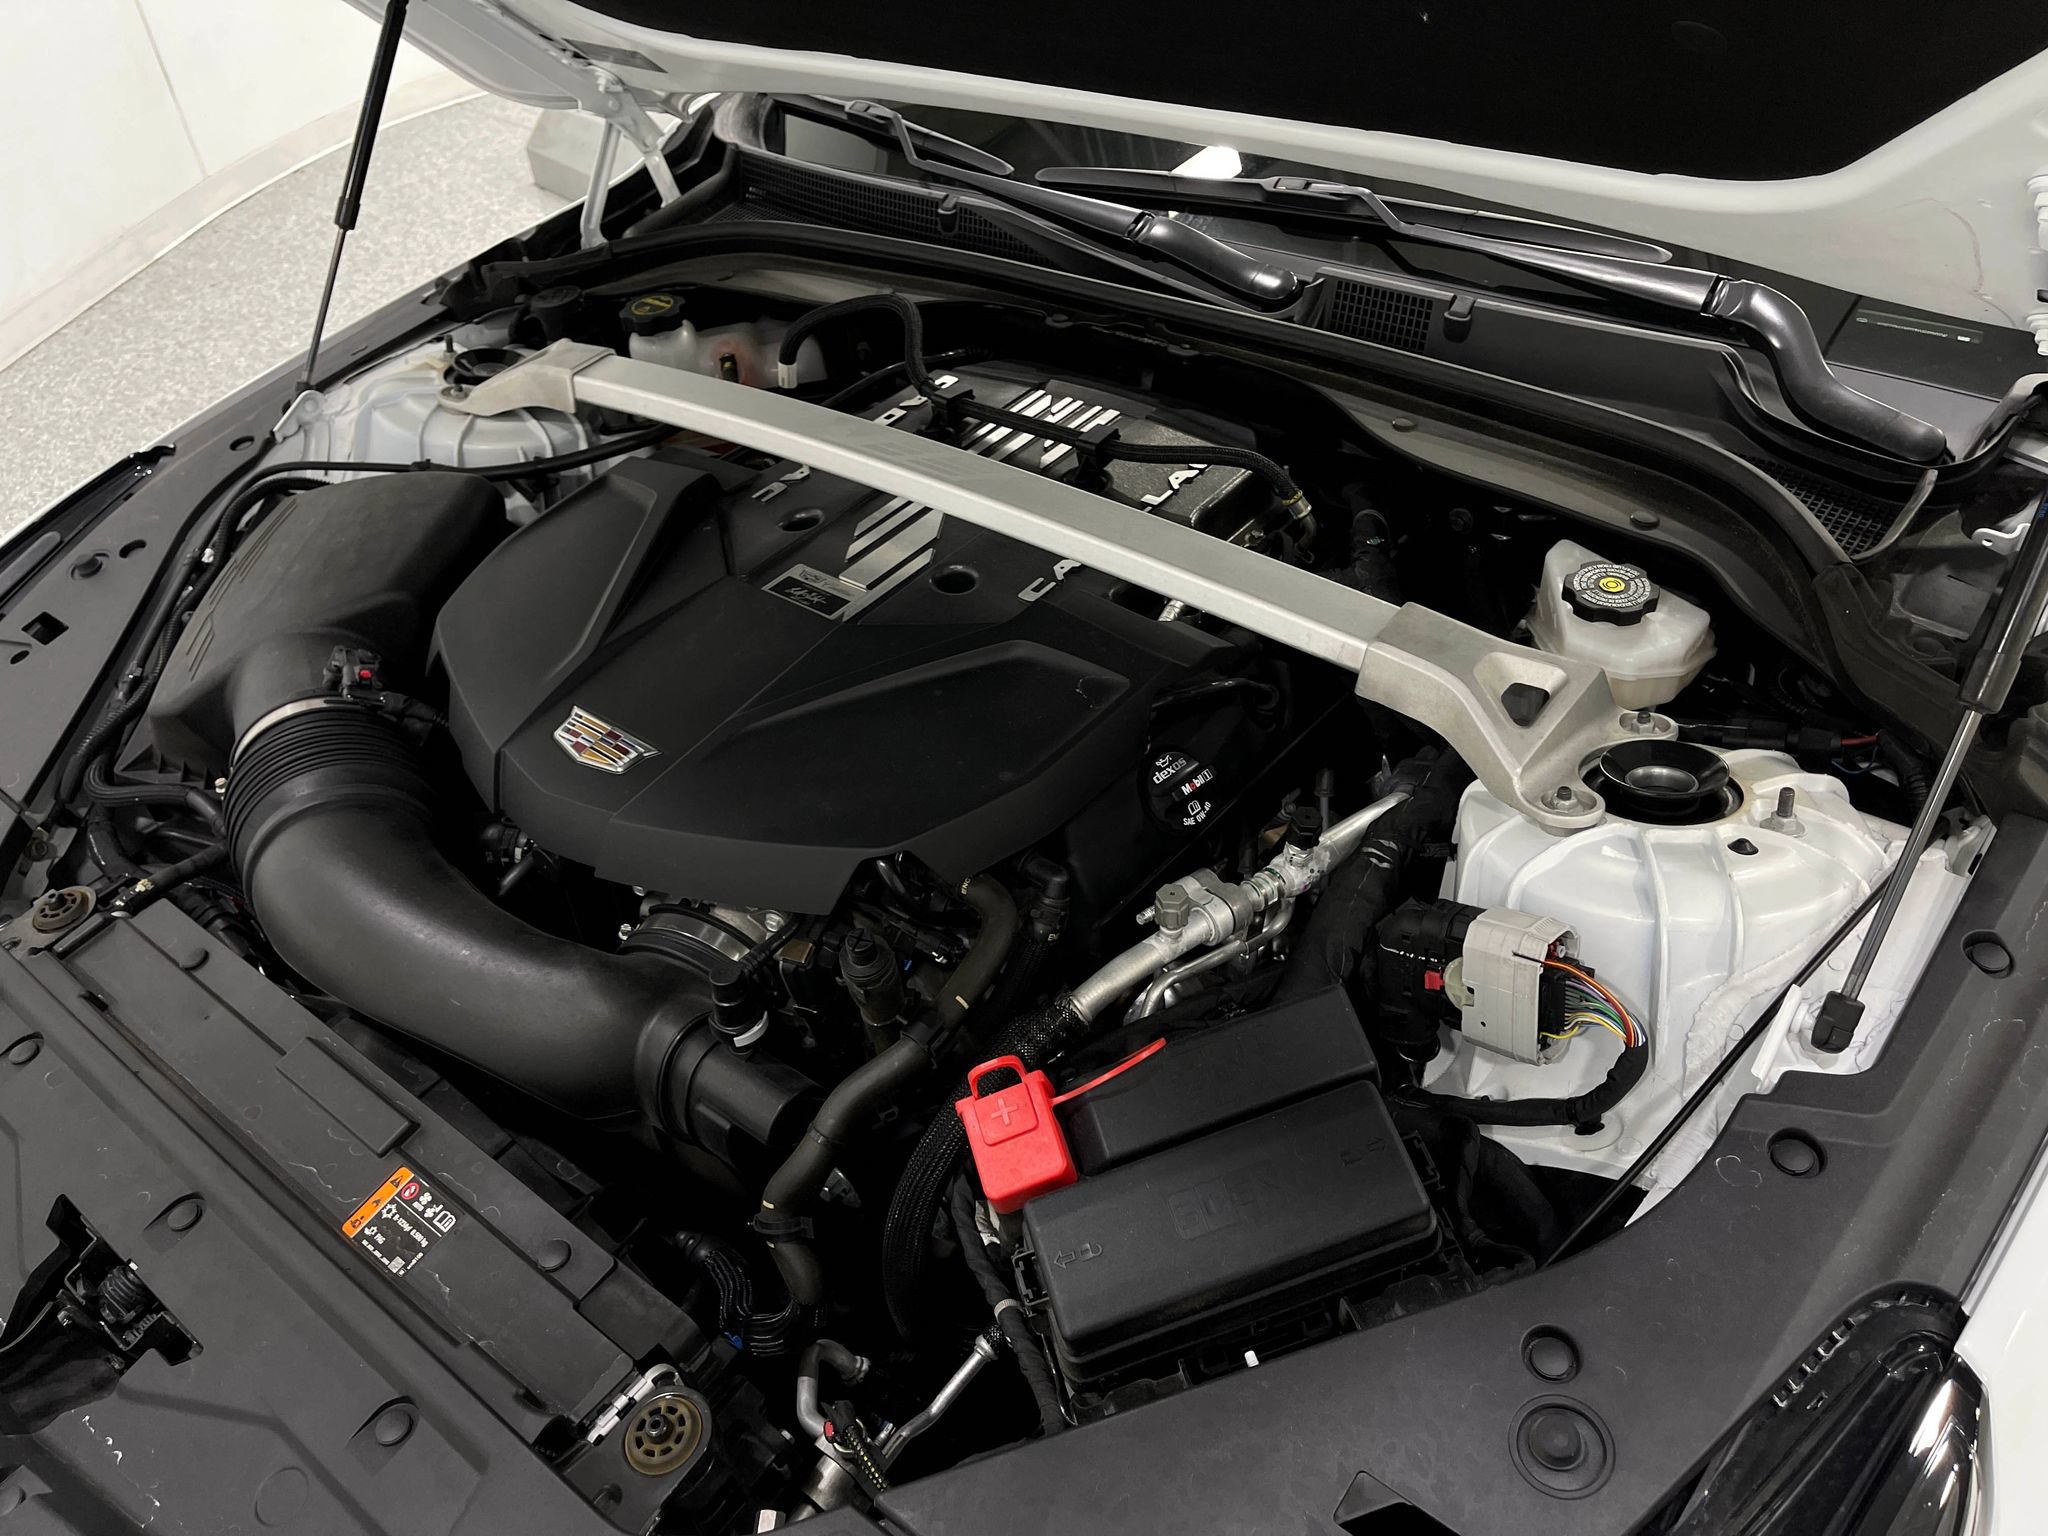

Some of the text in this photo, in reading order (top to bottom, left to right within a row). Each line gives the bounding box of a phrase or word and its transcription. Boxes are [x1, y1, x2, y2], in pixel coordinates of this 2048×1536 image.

[1153, 757, 1187, 784] dexos
[1183, 801, 1211, 825] SAE 0W-40
